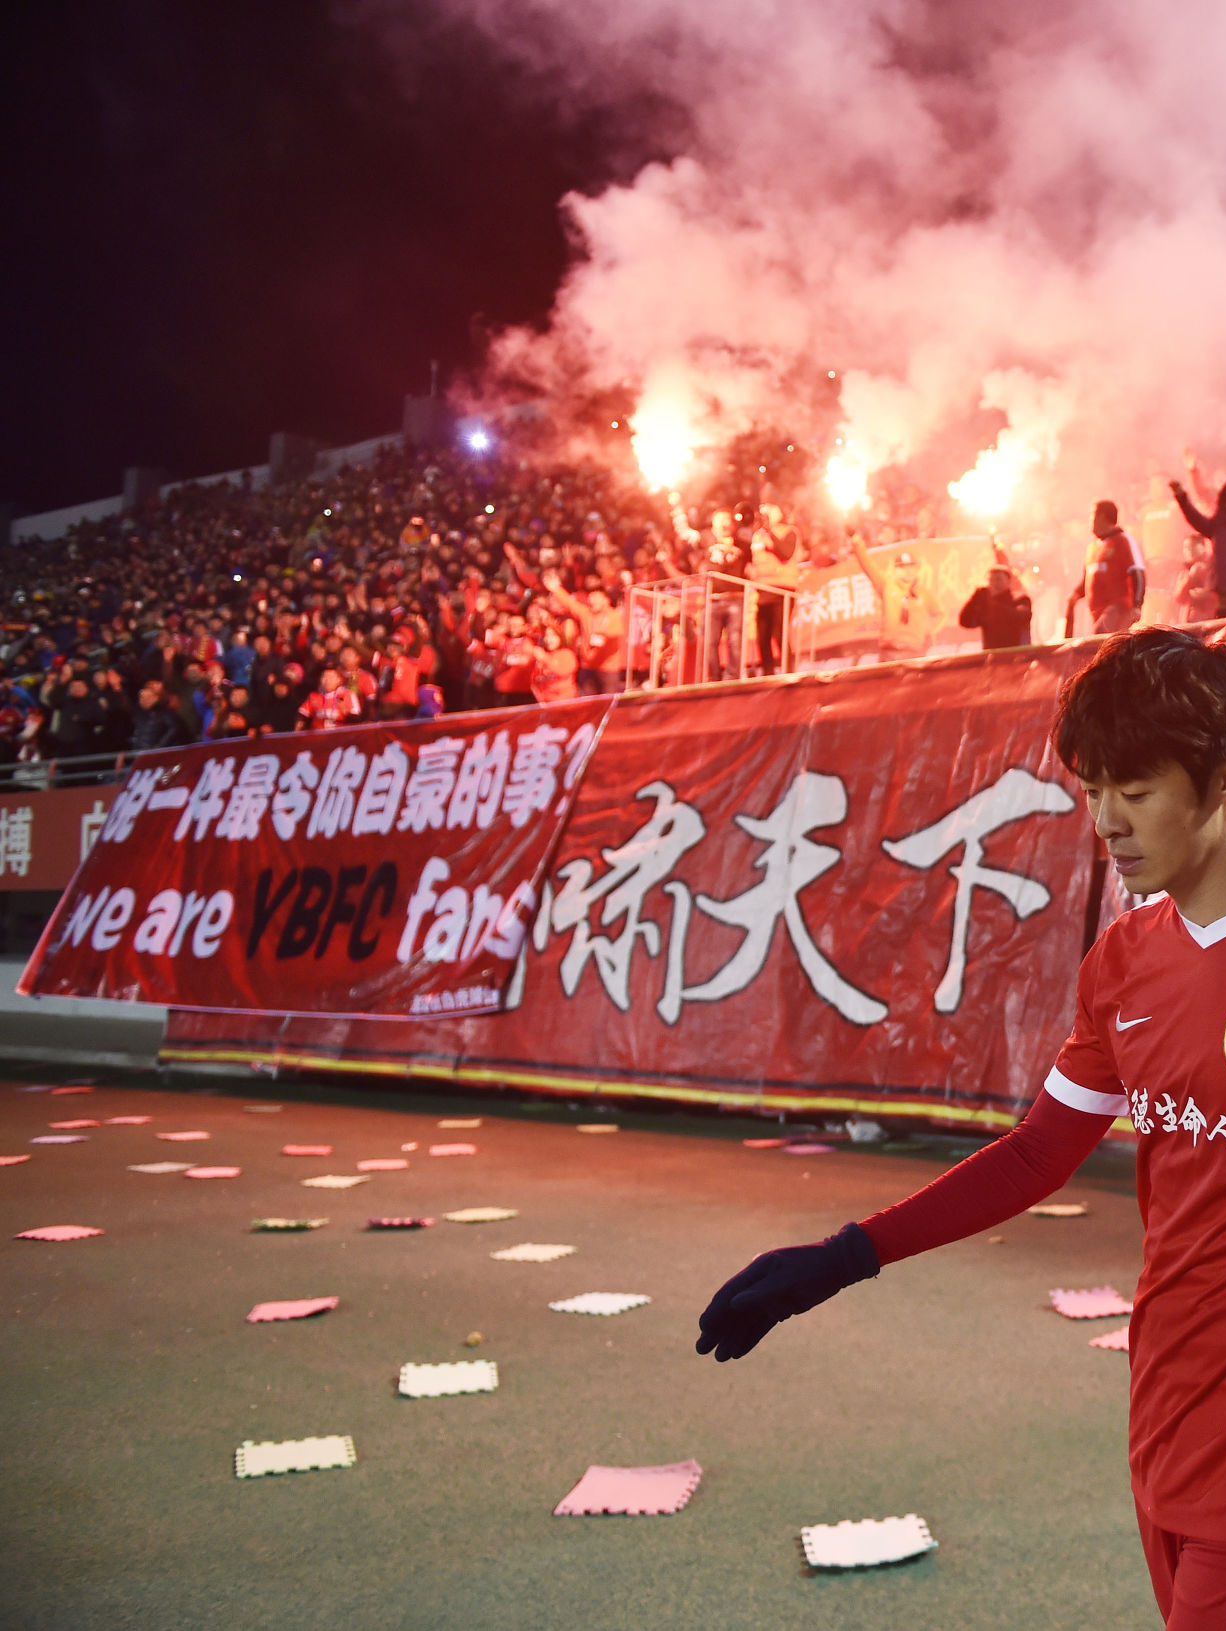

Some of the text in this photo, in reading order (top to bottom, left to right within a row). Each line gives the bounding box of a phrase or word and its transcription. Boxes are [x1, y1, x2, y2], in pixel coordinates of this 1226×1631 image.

[59, 856, 536, 964] we are YBFC fans
